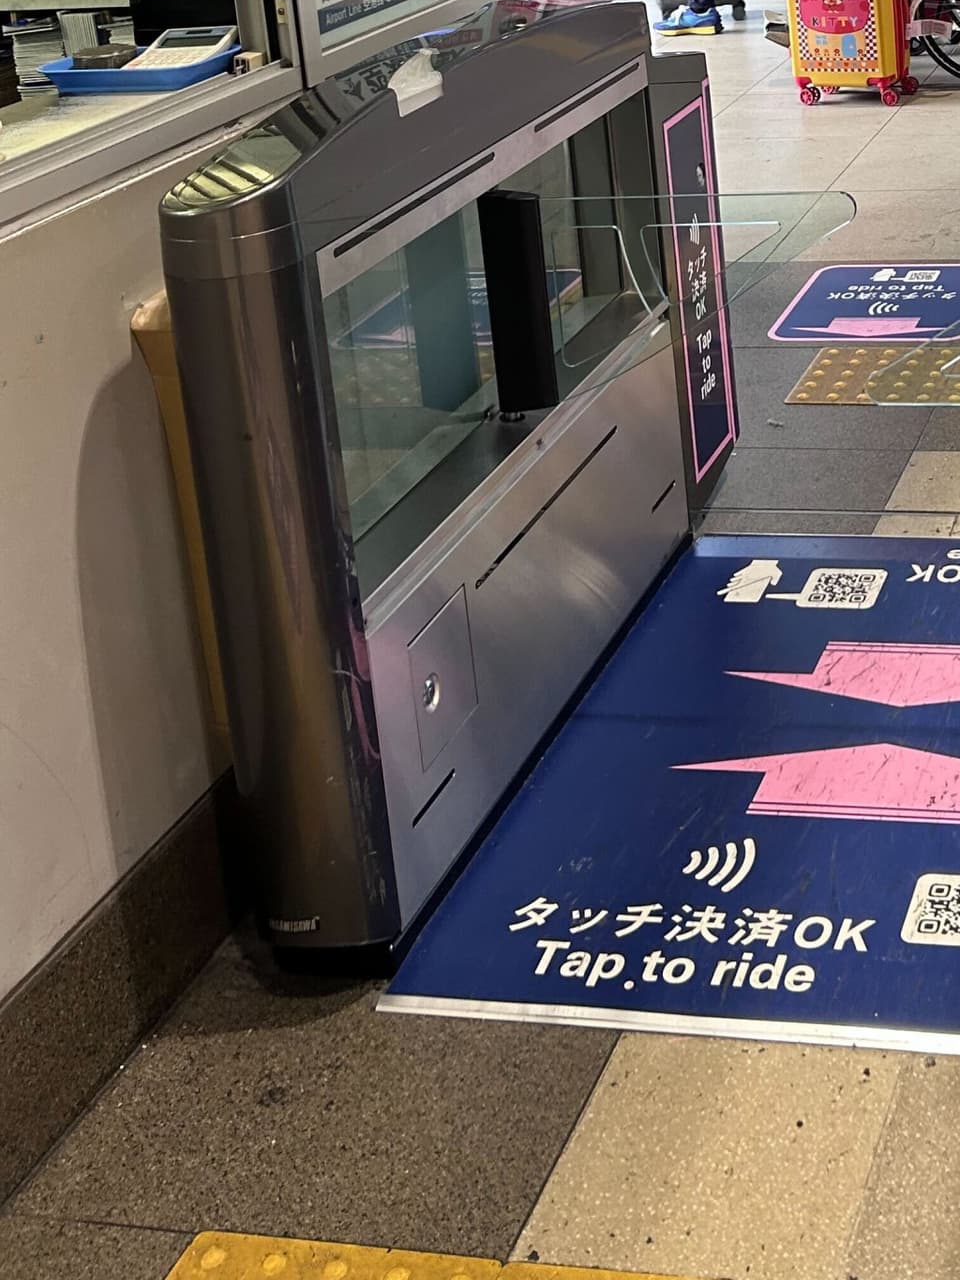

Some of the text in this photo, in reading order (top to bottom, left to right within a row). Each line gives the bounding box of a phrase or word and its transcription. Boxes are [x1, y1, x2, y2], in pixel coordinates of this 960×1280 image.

[812, 16, 858, 28] KITTY
[696, 327, 713, 354] Tap
[702, 354, 711, 375] to
[701, 372, 717, 401] ride
[508, 896, 877, 953] タッチ決済OK
[532, 939, 816, 992] Tap to ride
